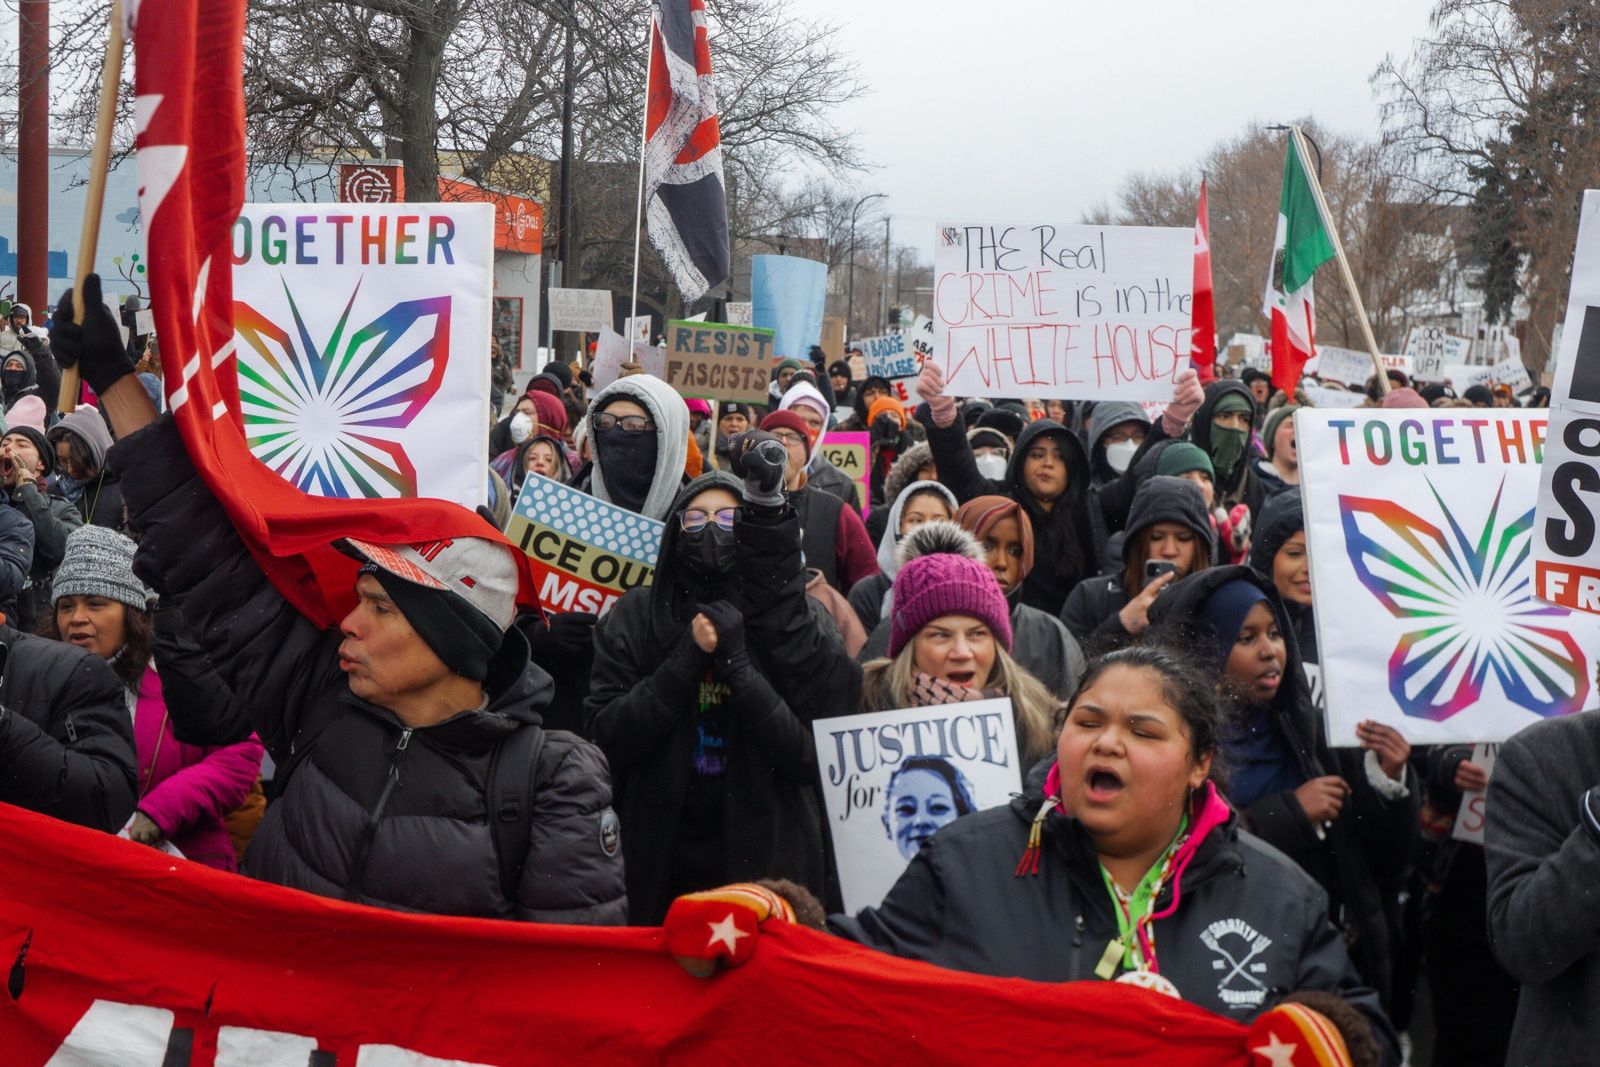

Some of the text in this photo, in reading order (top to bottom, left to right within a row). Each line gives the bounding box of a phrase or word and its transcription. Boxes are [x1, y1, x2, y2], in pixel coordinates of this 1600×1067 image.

[963, 225, 1106, 273] THE Real
[936, 270, 1058, 326] CRIME
[1076, 282, 1102, 318] is
[675, 327, 774, 360] RESIST
[870, 335, 904, 357] BADGE
[1418, 326, 1444, 341] LOCK
[1418, 342, 1443, 357] HIM
[667, 360, 767, 391] FASCISTS
[946, 322, 1192, 389] WHITE HOUSE
[1416, 358, 1440, 376] UP!
[519, 522, 655, 592] ICE OU
[828, 712, 1010, 787] JUSTICE
[840, 772, 881, 821] for
